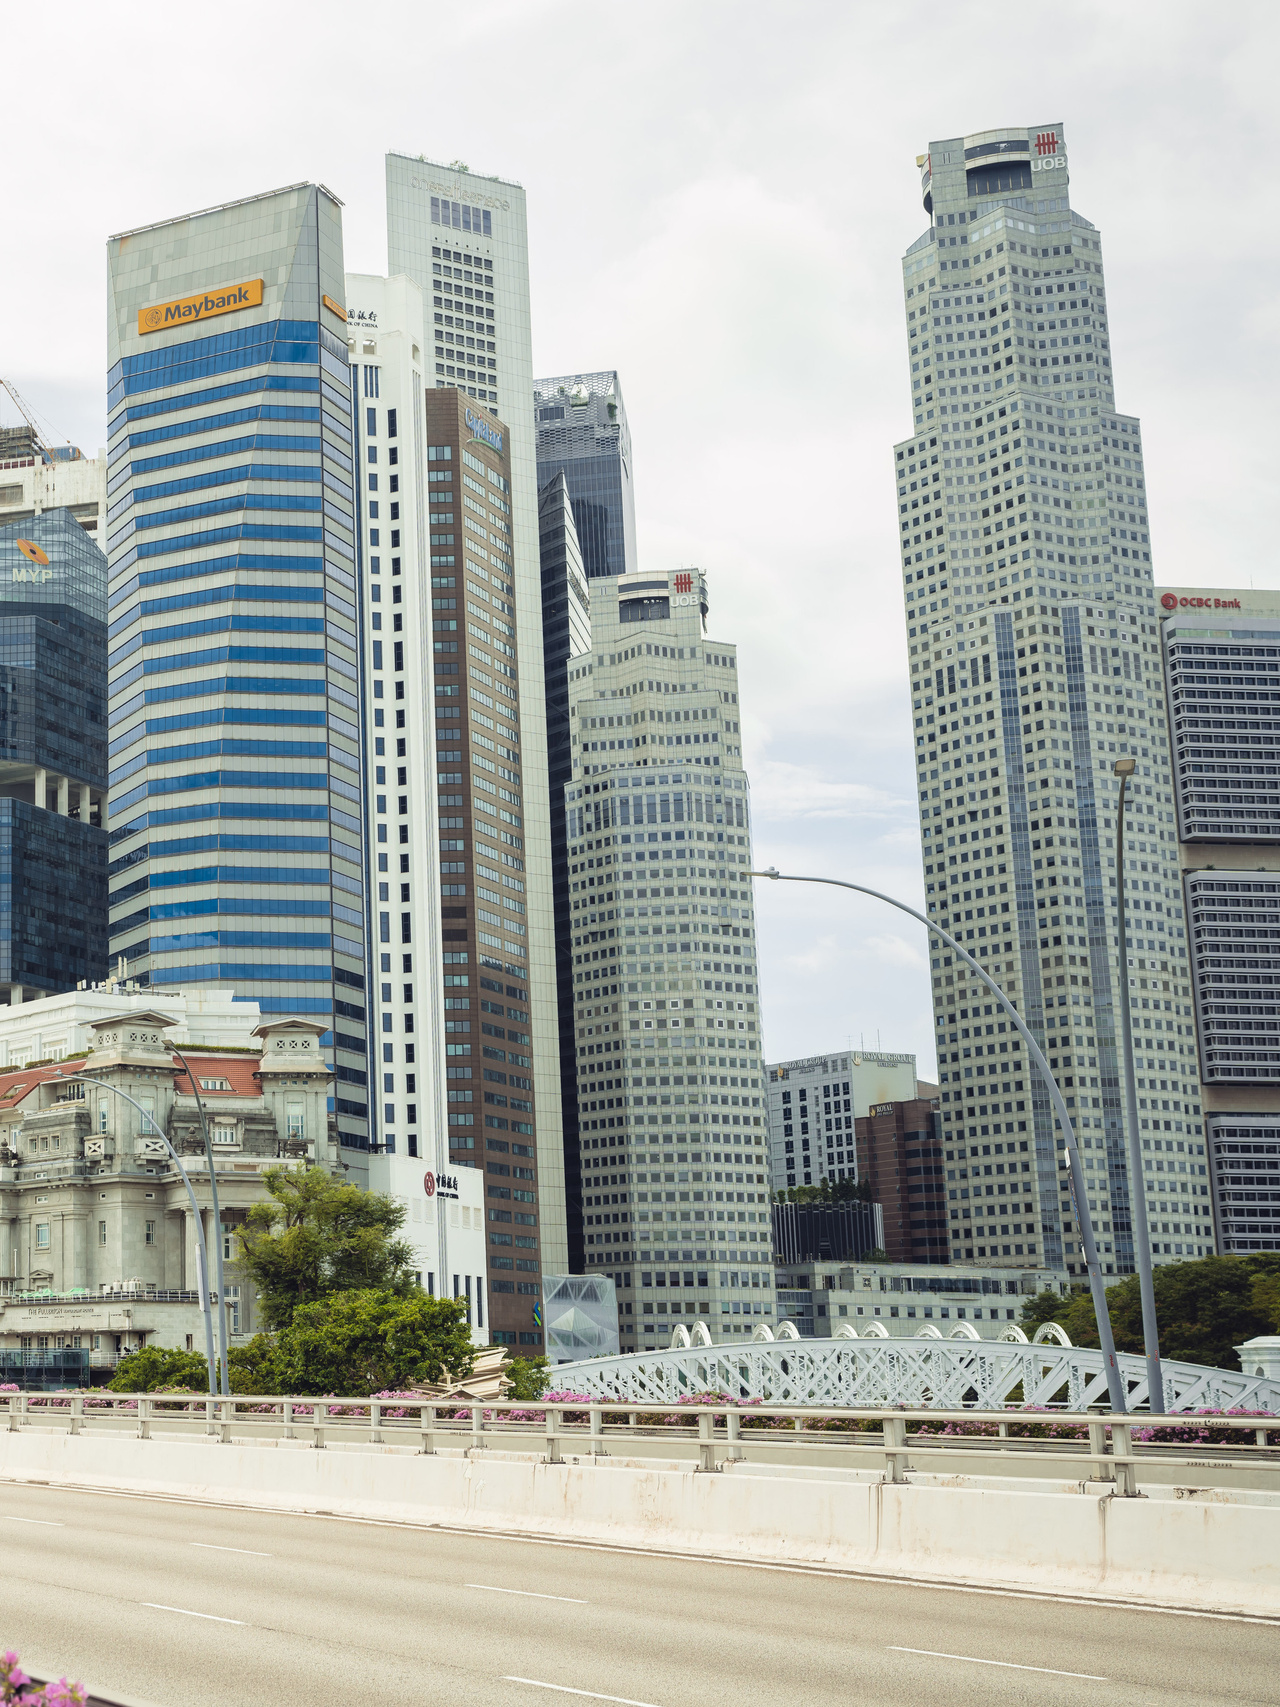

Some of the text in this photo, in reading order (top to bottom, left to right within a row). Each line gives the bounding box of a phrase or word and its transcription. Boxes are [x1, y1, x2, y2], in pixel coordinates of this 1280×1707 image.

[1031, 157, 1066, 172] UOB
[164, 287, 250, 322] Maybank
[12, 568, 53, 583] MYP
[671, 595, 699, 608] UOB
[1179, 597, 1241, 608] OCBC Bank
